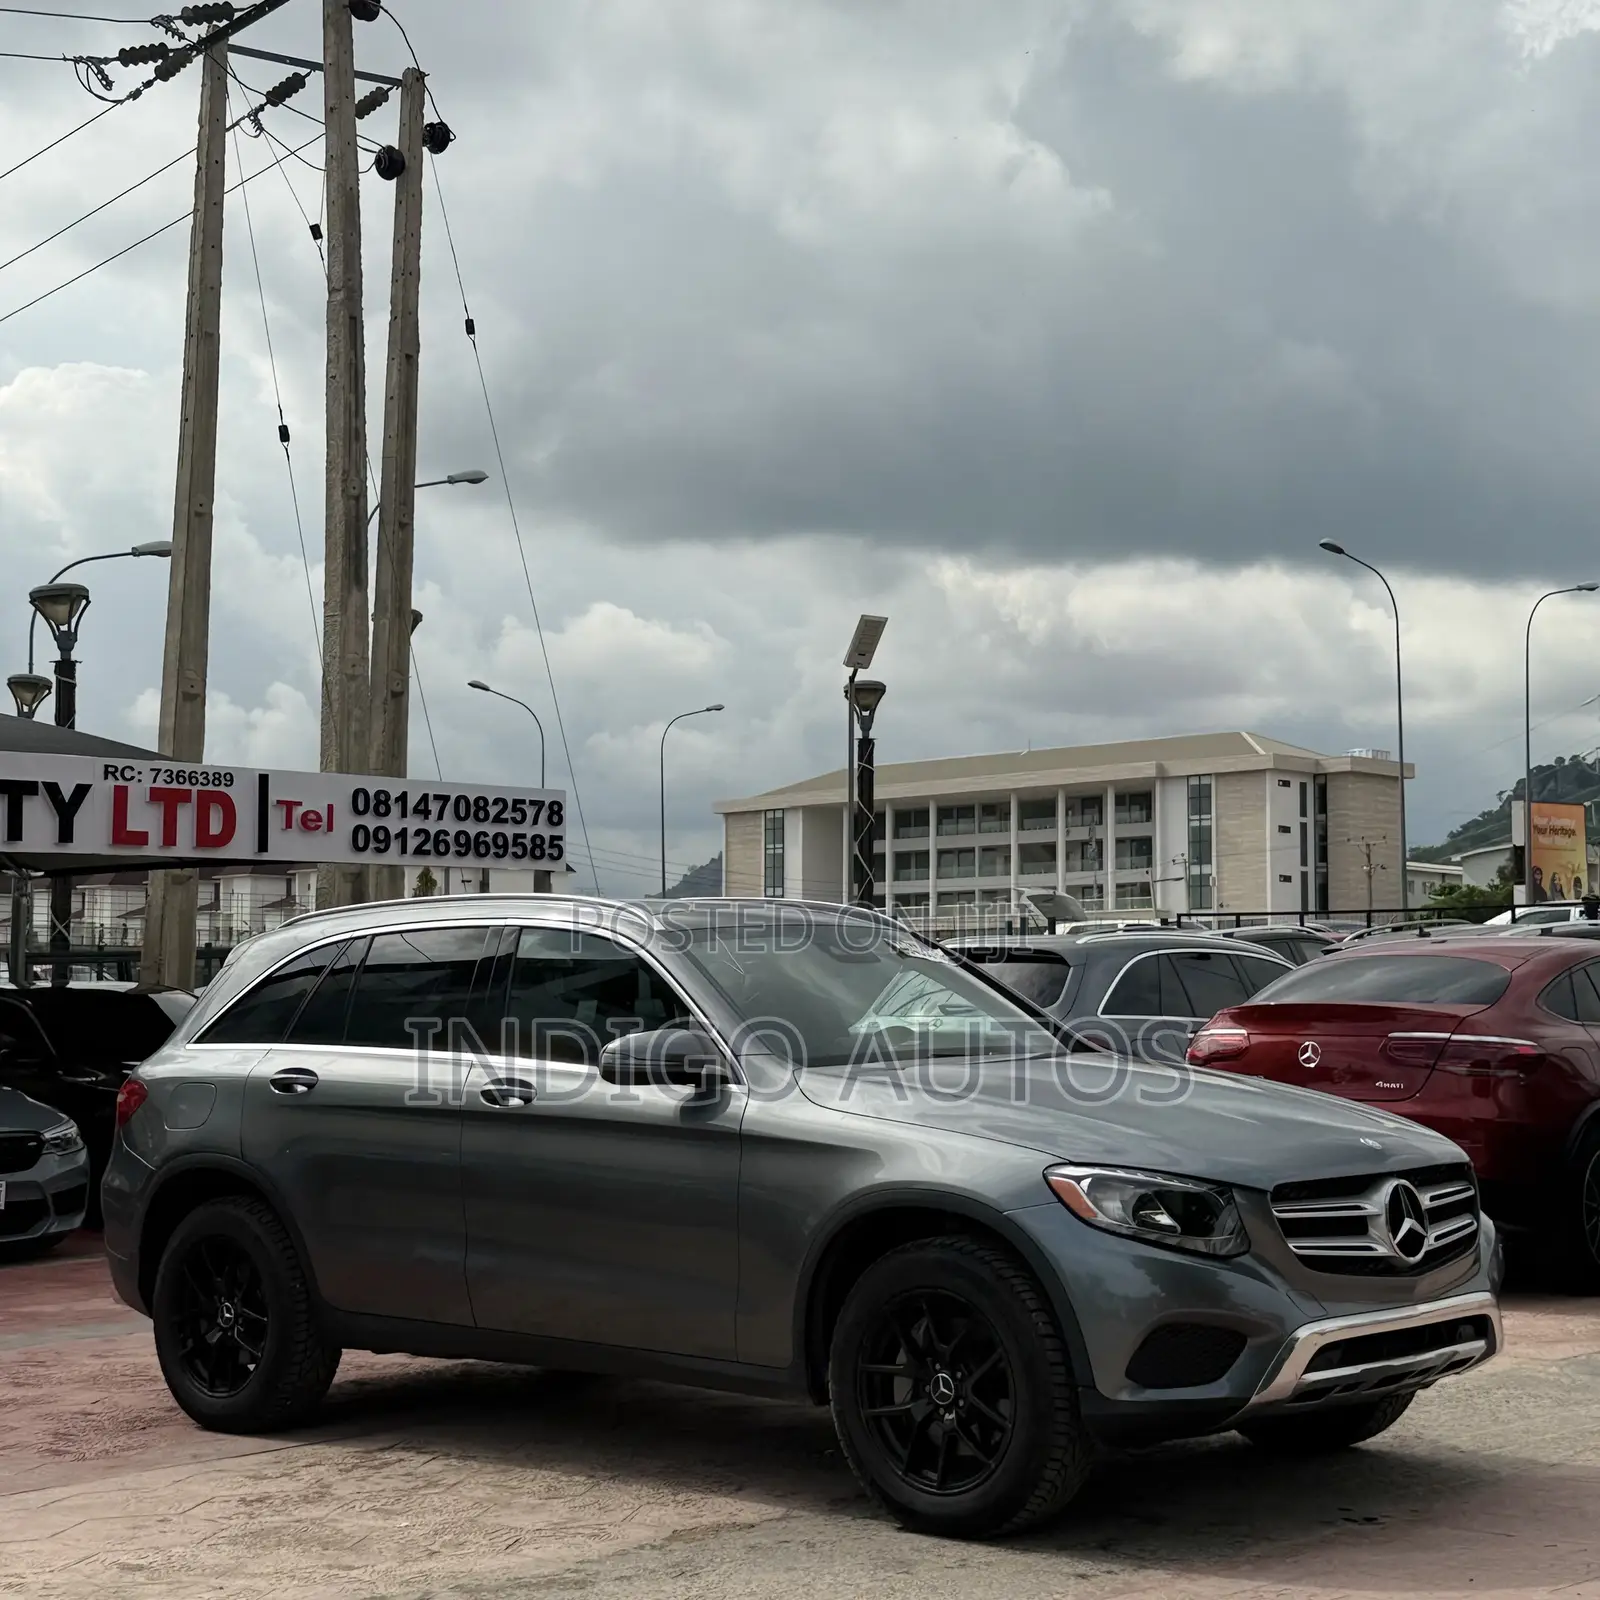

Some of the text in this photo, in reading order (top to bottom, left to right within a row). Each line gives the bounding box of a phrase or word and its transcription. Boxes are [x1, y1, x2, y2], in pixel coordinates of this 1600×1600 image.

[103, 764, 235, 788] RC: 7366389
[111, 785, 237, 848] LTD
[275, 799, 334, 833] Tel
[351, 787, 564, 827] 08147082578
[351, 824, 564, 861] 09126969585
